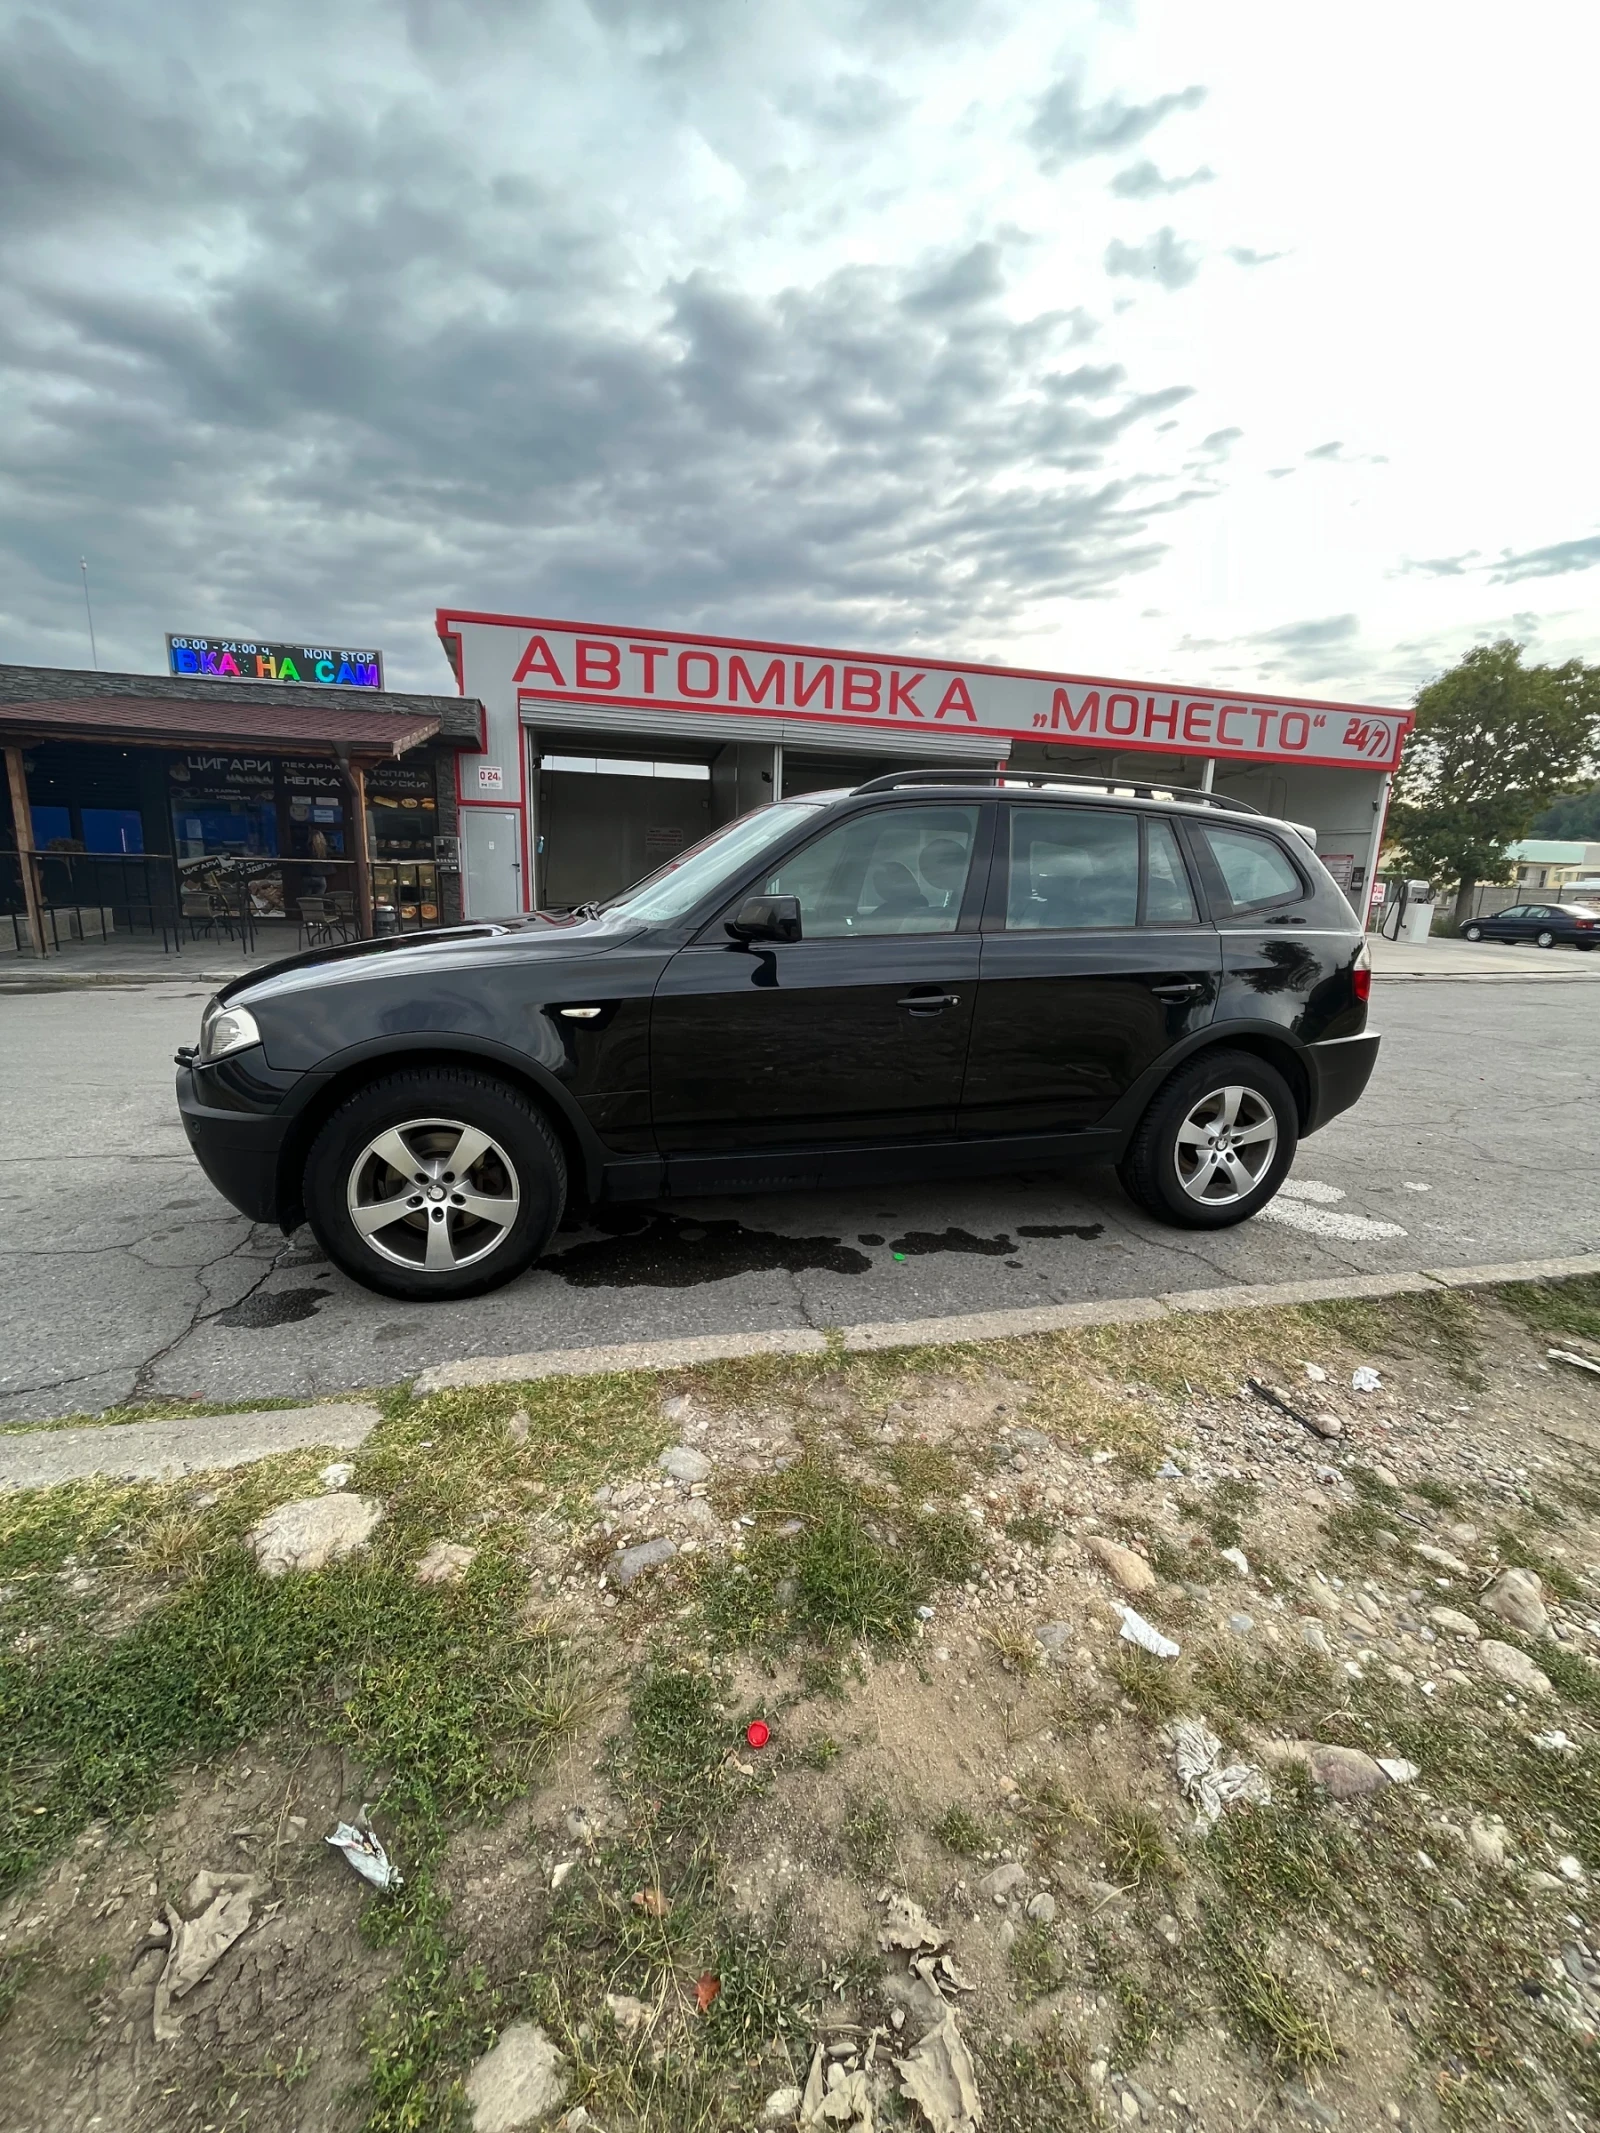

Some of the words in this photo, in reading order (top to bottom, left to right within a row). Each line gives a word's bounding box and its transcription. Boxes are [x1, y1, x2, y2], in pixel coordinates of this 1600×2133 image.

[171, 637, 208, 650] 00:00
[221, 641, 257, 655] 24:00
[303, 648, 333, 661] NON
[340, 651, 375, 664] STOP
[171, 648, 241, 676] ВКА
[255, 655, 301, 681] НА
[315, 660, 379, 686] САМ
[511, 635, 979, 722] АВТОМИВКА
[1032, 687, 1327, 751] „МОНЕСТО“
[1342, 717, 1391, 758] 24/7
[187, 756, 272, 773] ЦИГАРИ
[281, 761, 341, 771] ПЕКАРНА
[283, 776, 341, 788] НЕЛКА
[372, 769, 415, 778] ТОПЛИ
[182, 859, 220, 876] ЦИГАРИ
